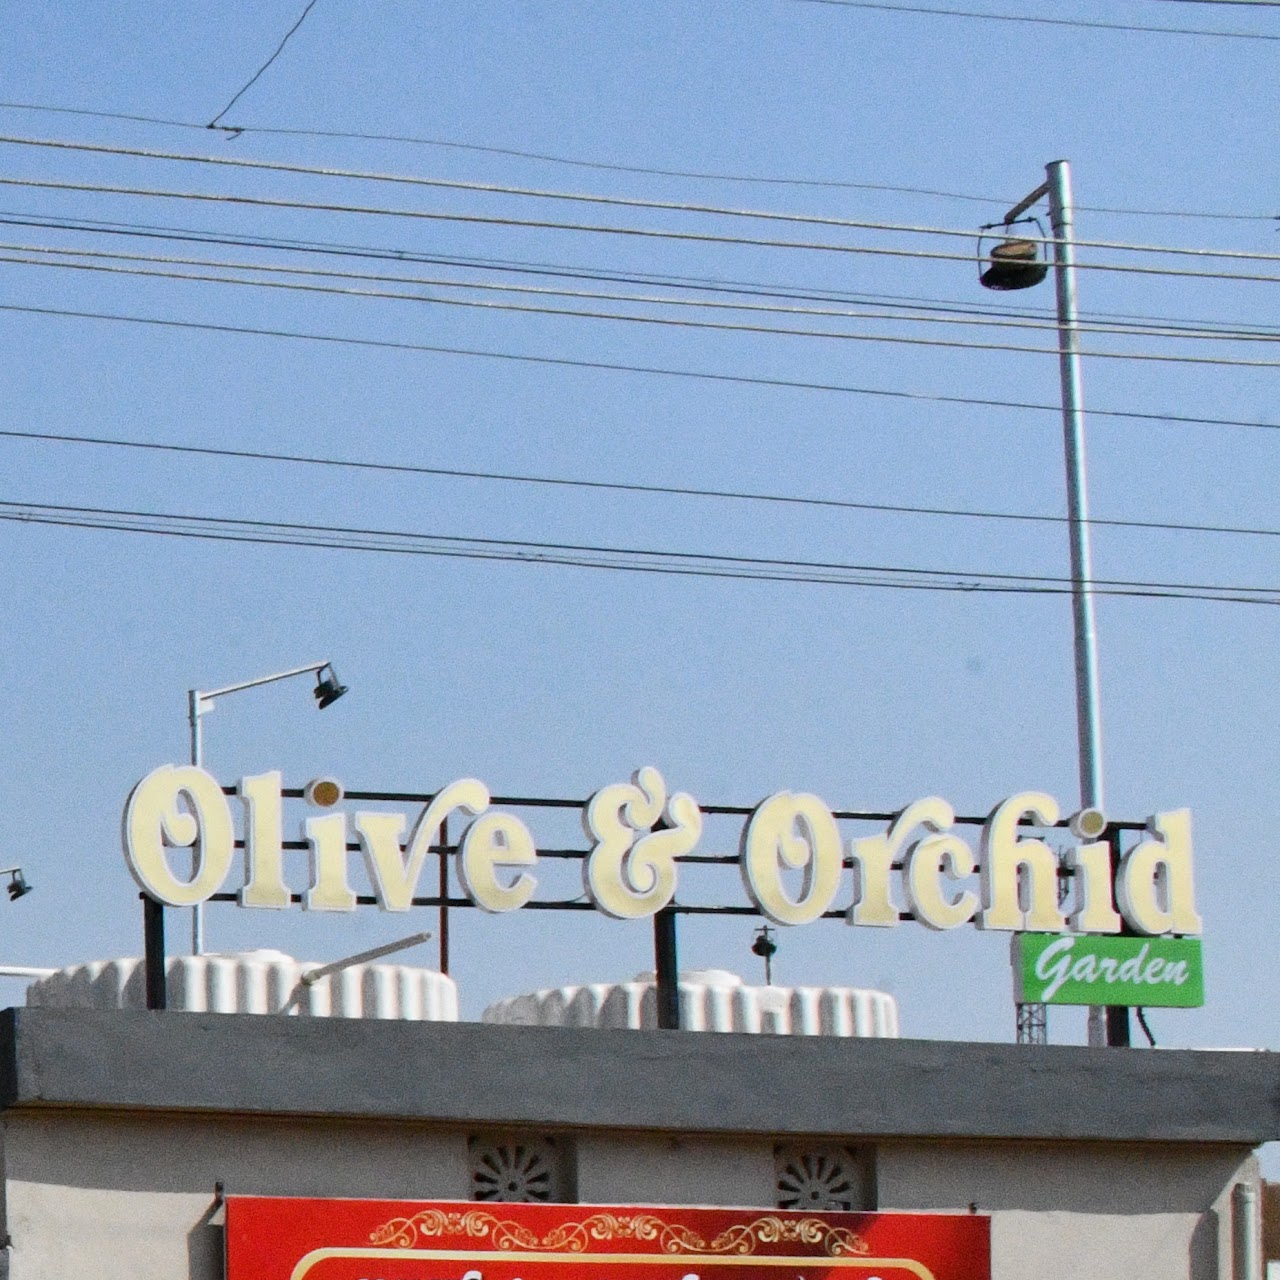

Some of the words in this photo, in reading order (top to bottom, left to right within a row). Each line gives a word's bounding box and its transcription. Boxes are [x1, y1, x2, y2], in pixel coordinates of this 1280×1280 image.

[122, 763, 538, 913] Olive
[582, 766, 702, 920] &
[740, 791, 1202, 935] Orchid
[1035, 936, 1189, 1001] Garden
